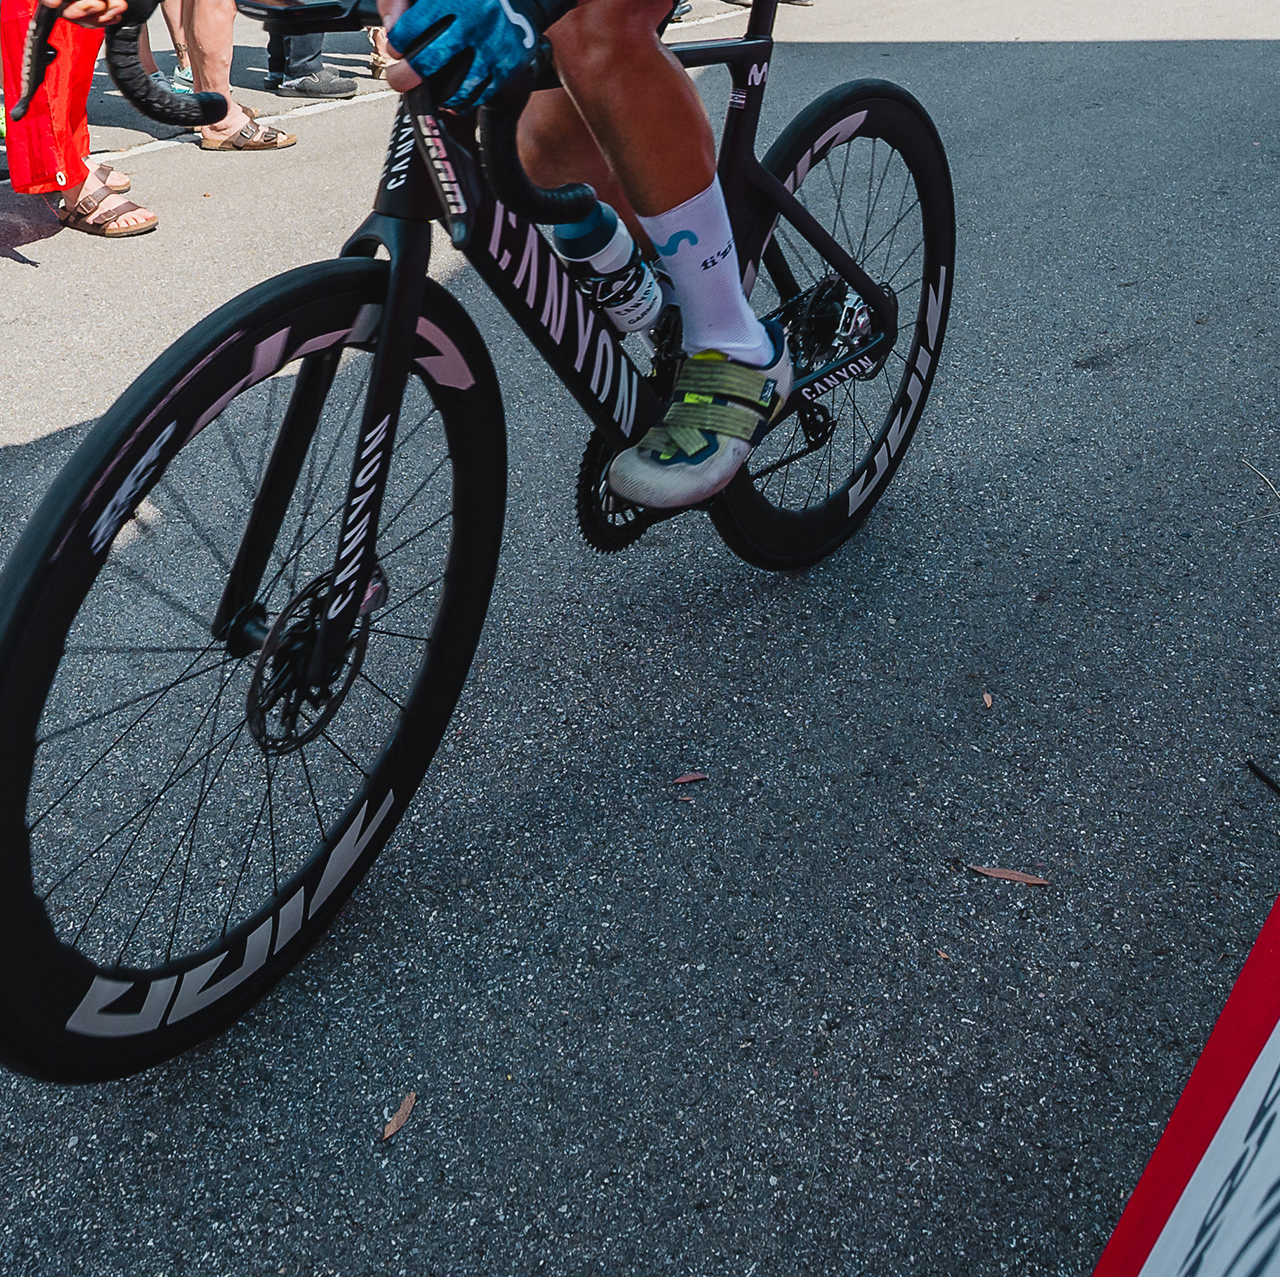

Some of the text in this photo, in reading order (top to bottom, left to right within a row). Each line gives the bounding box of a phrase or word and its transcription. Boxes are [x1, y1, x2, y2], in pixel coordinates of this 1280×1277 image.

[487, 199, 639, 439] CANYON
[801, 355, 875, 401] CANYON
[327, 413, 391, 621] CANYON
[64, 788, 396, 1039] ZIPP
